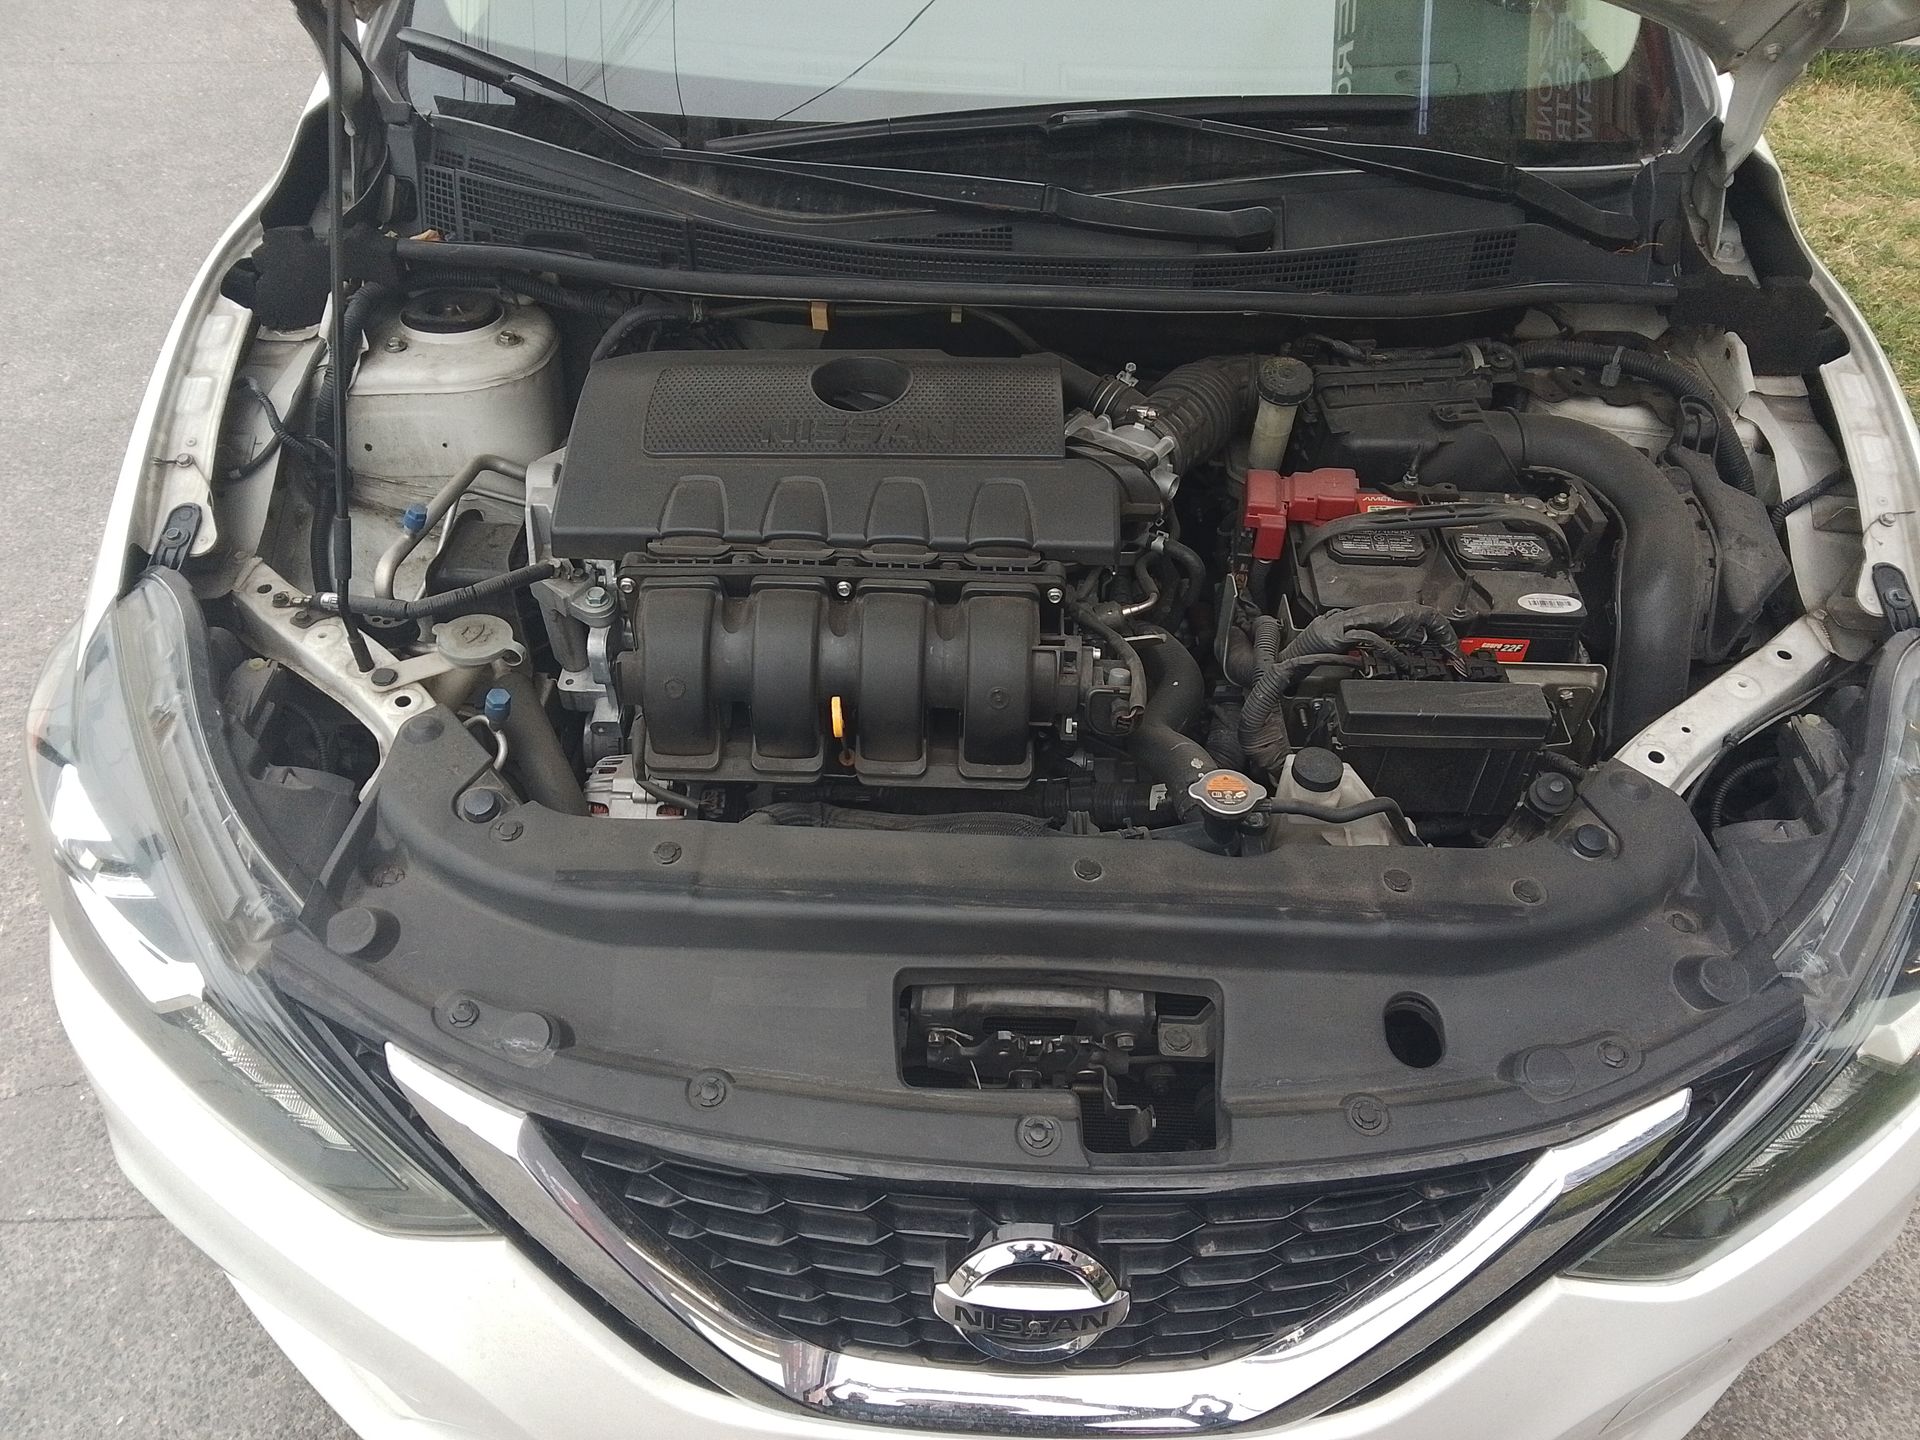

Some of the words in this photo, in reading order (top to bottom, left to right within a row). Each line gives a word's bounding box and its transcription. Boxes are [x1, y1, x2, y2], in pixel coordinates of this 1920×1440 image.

[762, 417, 957, 444] NISSAN
[1500, 644, 1523, 652] 22F
[954, 1305, 1109, 1336] NISSAN
